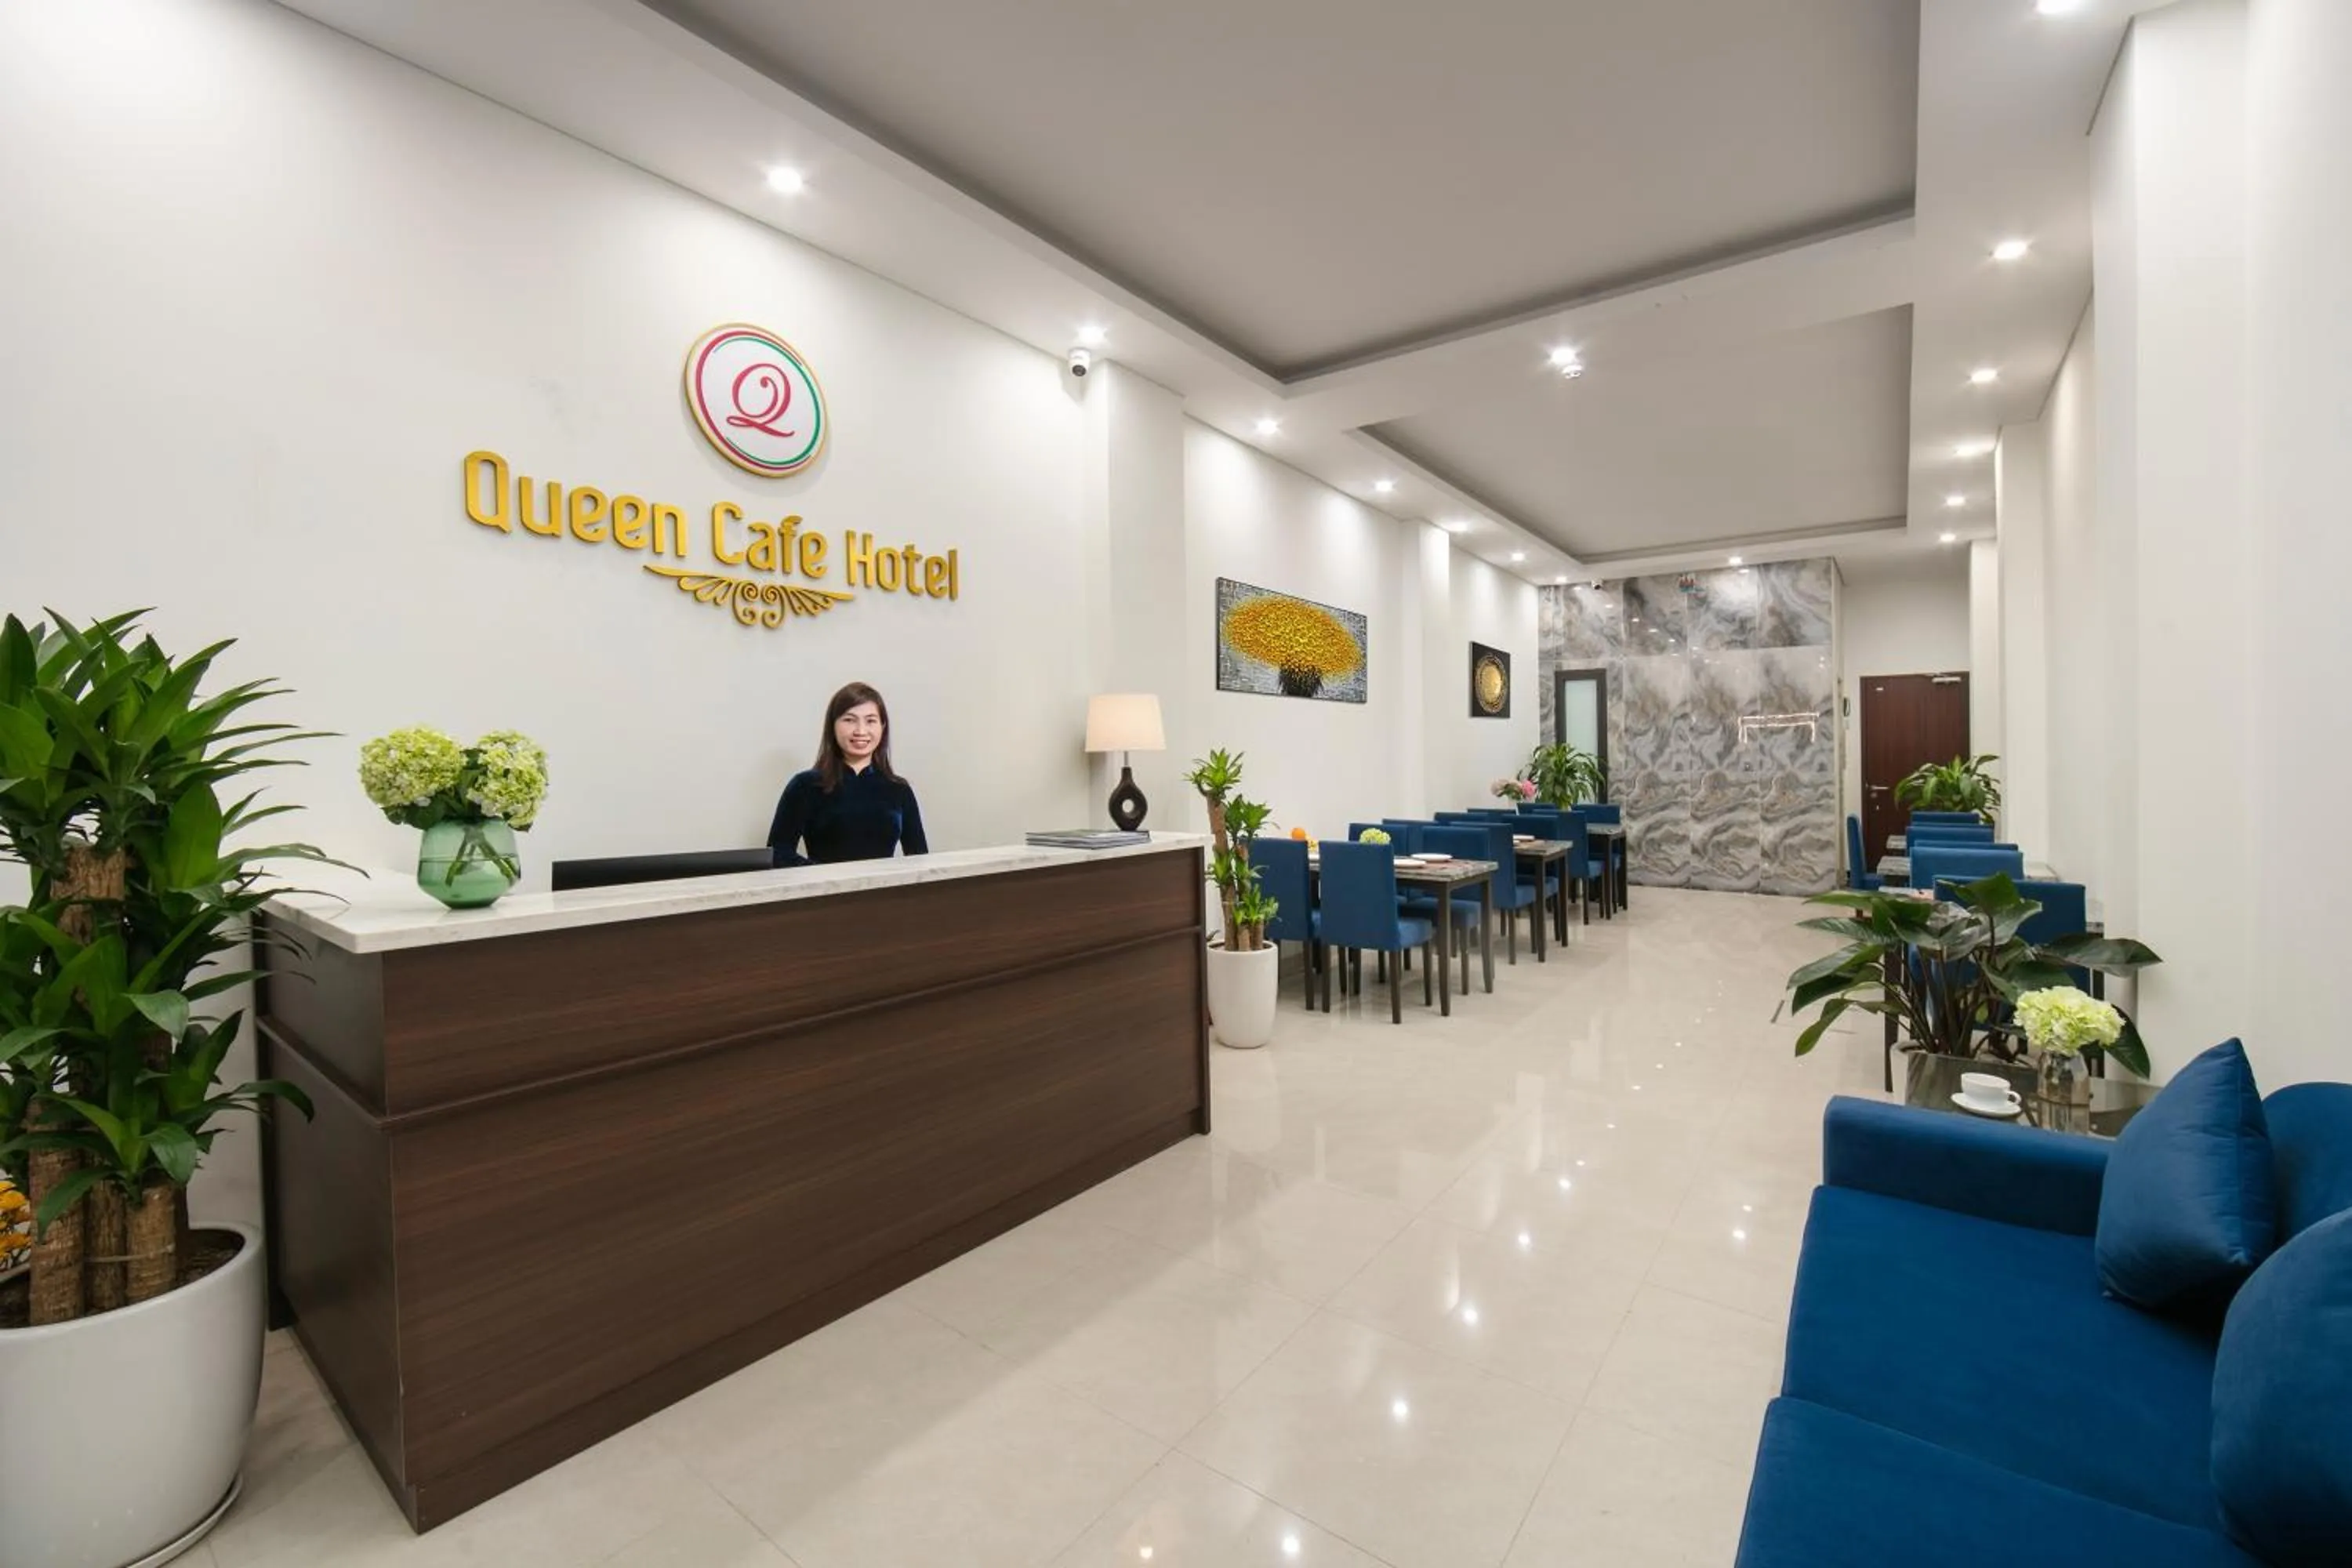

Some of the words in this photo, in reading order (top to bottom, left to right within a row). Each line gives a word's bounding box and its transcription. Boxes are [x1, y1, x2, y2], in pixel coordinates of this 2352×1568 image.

[726, 363, 795, 437] Q
[463, 450, 688, 557] Queen
[712, 501, 828, 579] Cafe
[847, 529, 958, 601] Hotel
